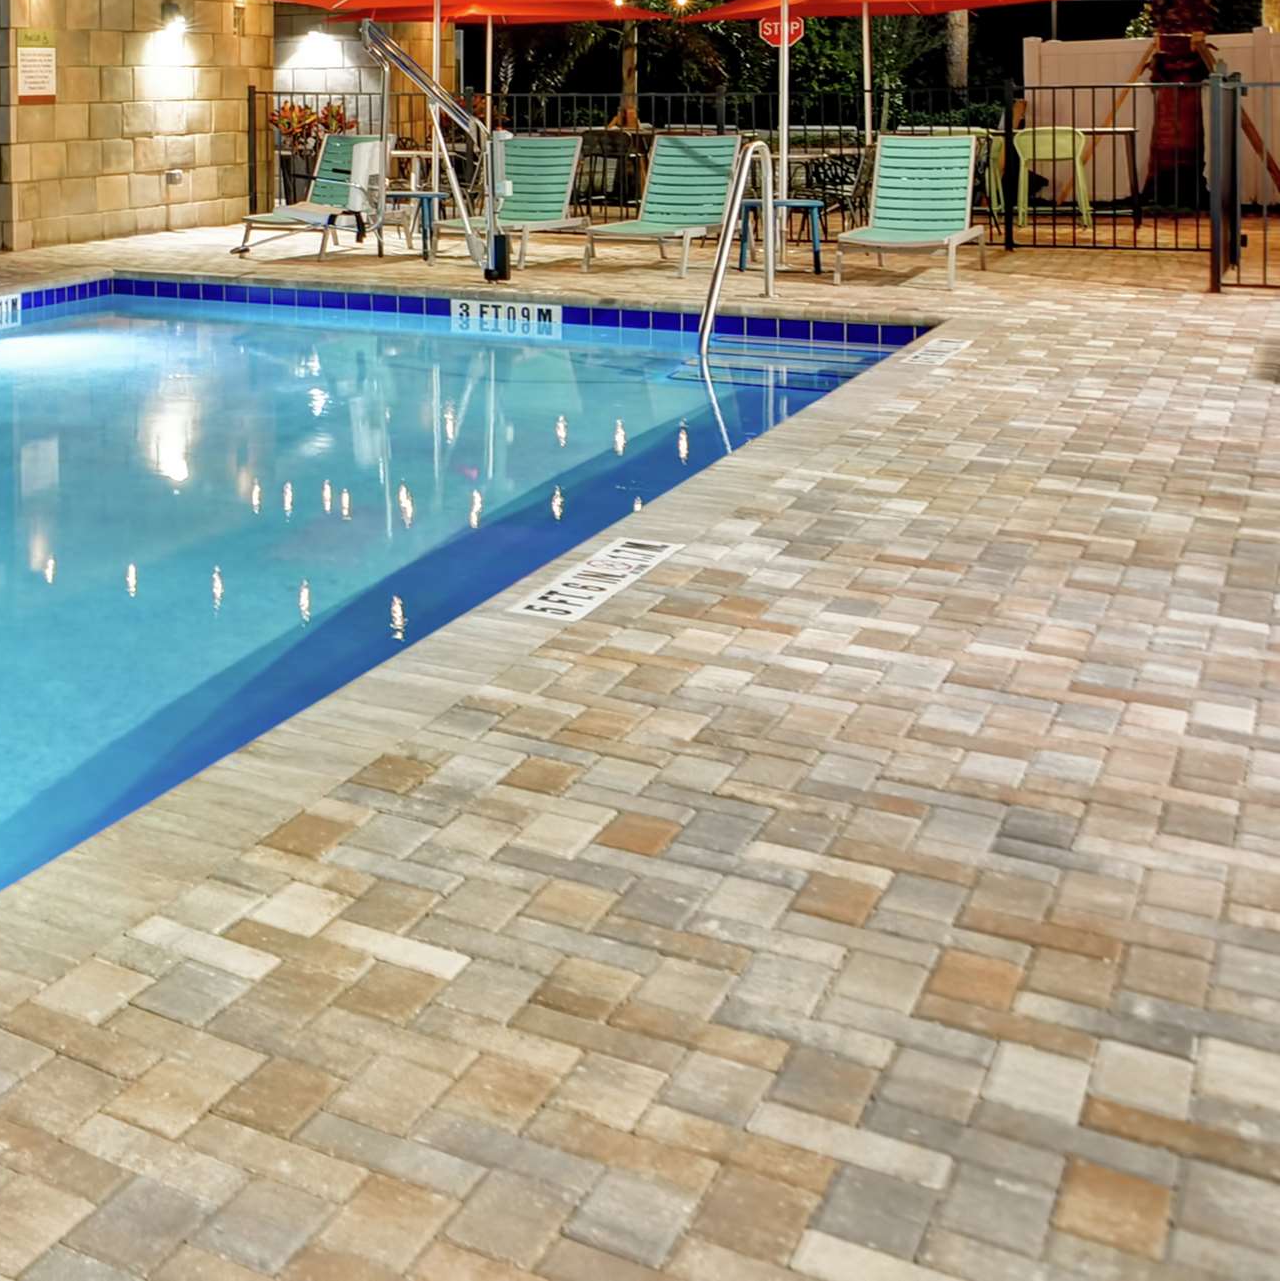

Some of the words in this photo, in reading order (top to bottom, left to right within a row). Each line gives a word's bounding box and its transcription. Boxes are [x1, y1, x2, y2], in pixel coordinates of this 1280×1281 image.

[762, 22, 800, 36] STP
[537, 308, 553, 323] M
[523, 604, 572, 616] 5
[562, 582, 607, 592] 6
